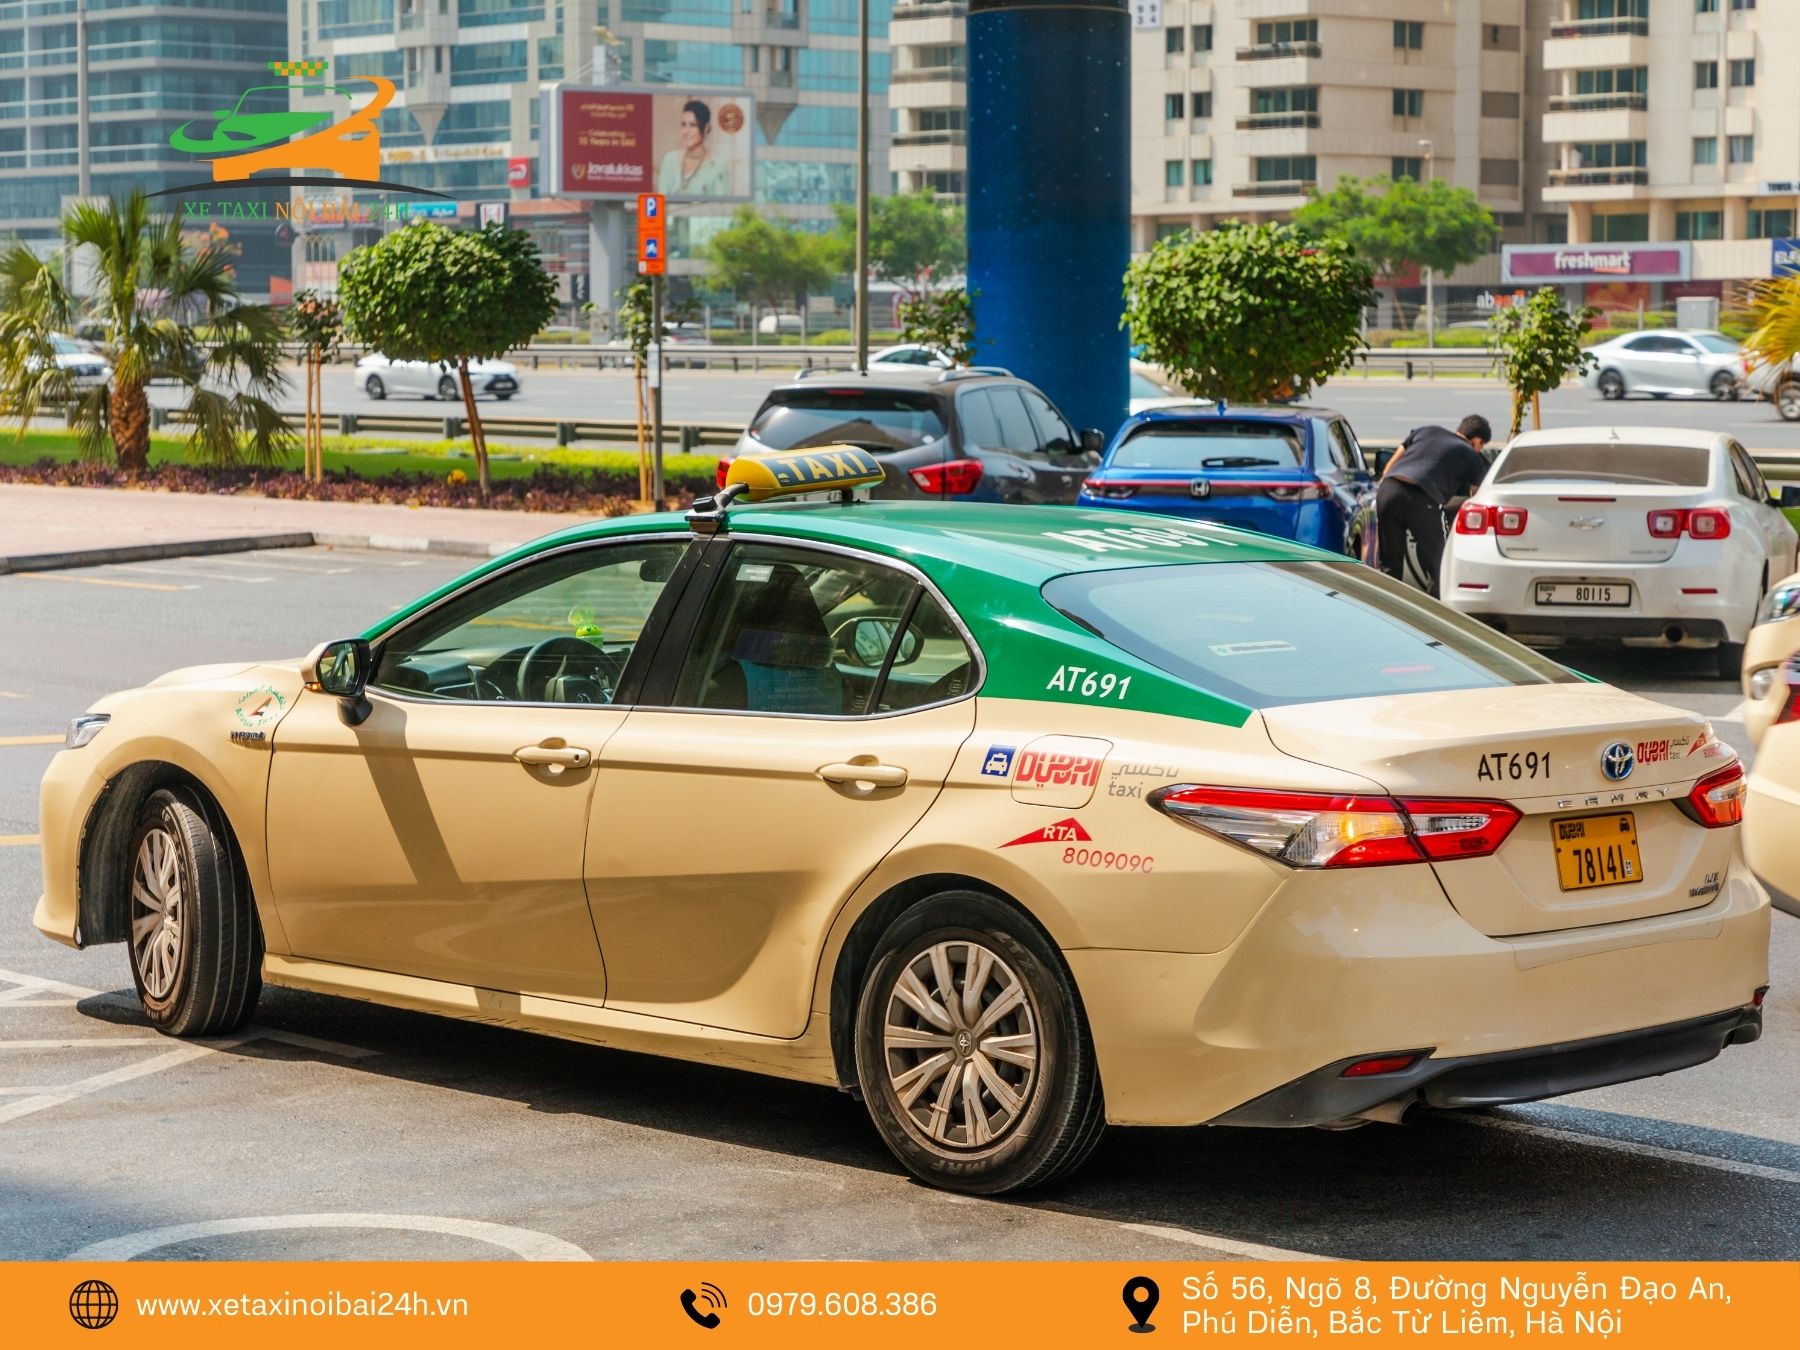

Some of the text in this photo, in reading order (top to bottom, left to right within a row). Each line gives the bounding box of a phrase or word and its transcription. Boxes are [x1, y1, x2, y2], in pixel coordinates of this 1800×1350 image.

[1554, 251, 1631, 270] freshmart
[780, 452, 869, 482] TAXI
[1576, 587, 1611, 602] 80115
[1045, 665, 1132, 700] AT691
[1015, 751, 1103, 788] DUBAI
[1477, 751, 1550, 782] AT691
[1108, 780, 1143, 799] taxi
[1042, 825, 1078, 842] RTA
[1573, 845, 1626, 884] 78141
